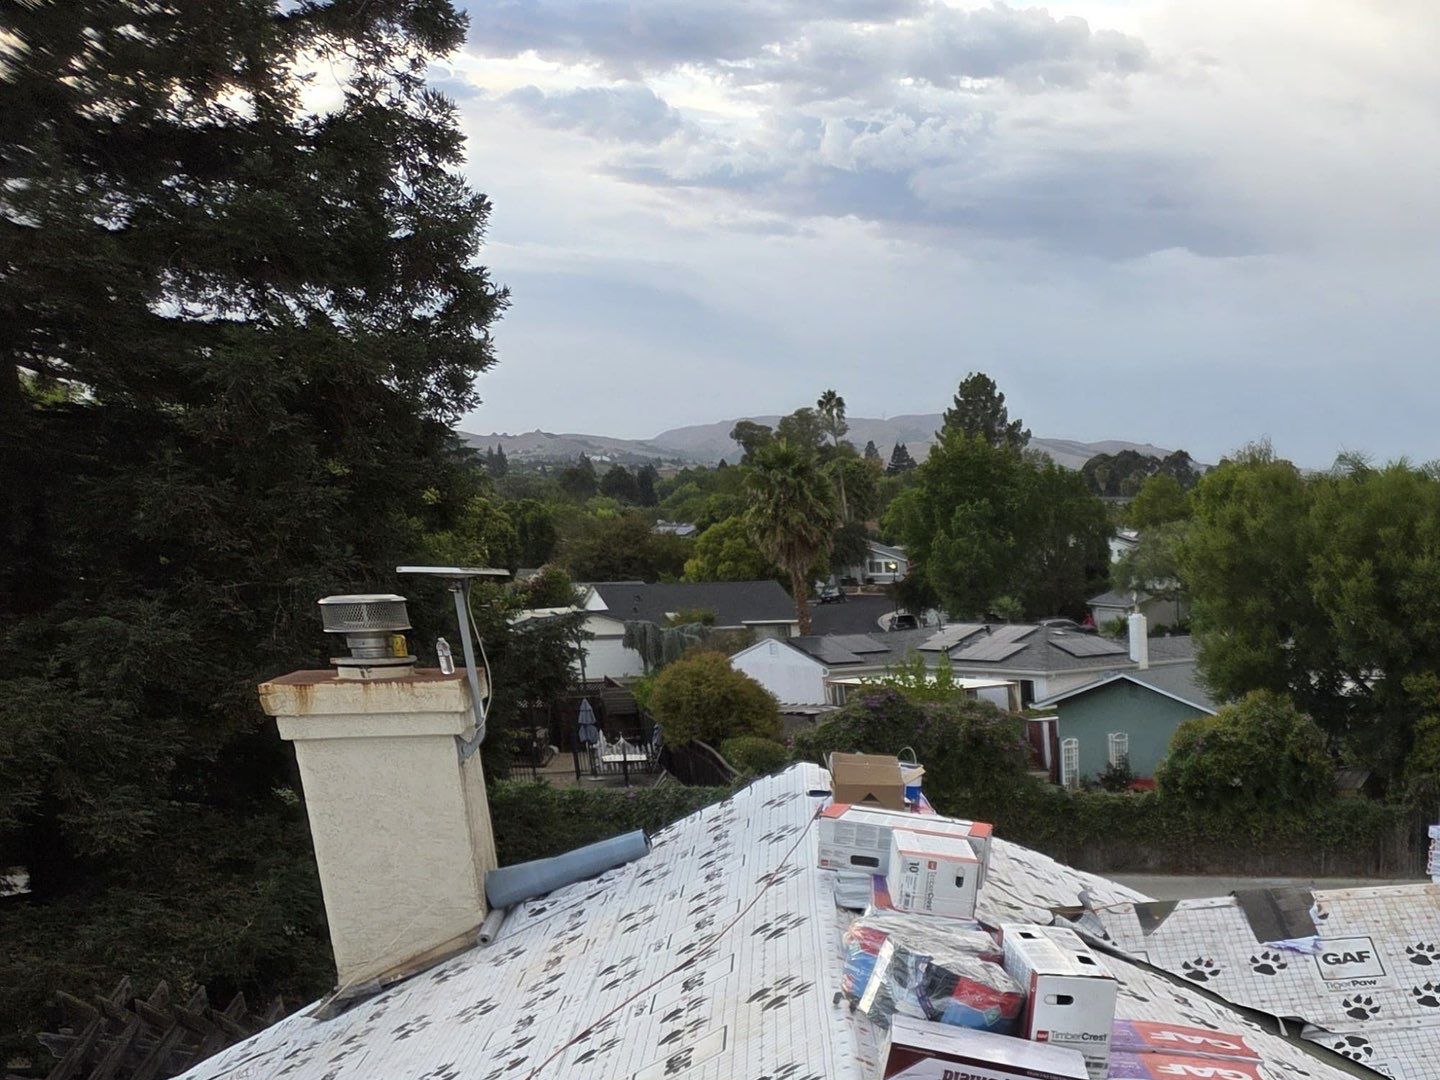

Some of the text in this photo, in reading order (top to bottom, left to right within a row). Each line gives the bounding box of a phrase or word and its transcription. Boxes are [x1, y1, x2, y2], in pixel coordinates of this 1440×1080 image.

[1322, 950, 1370, 965] GAF
[1323, 979, 1378, 989] TigerPaw
[1150, 1031, 1241, 1050] GAF
